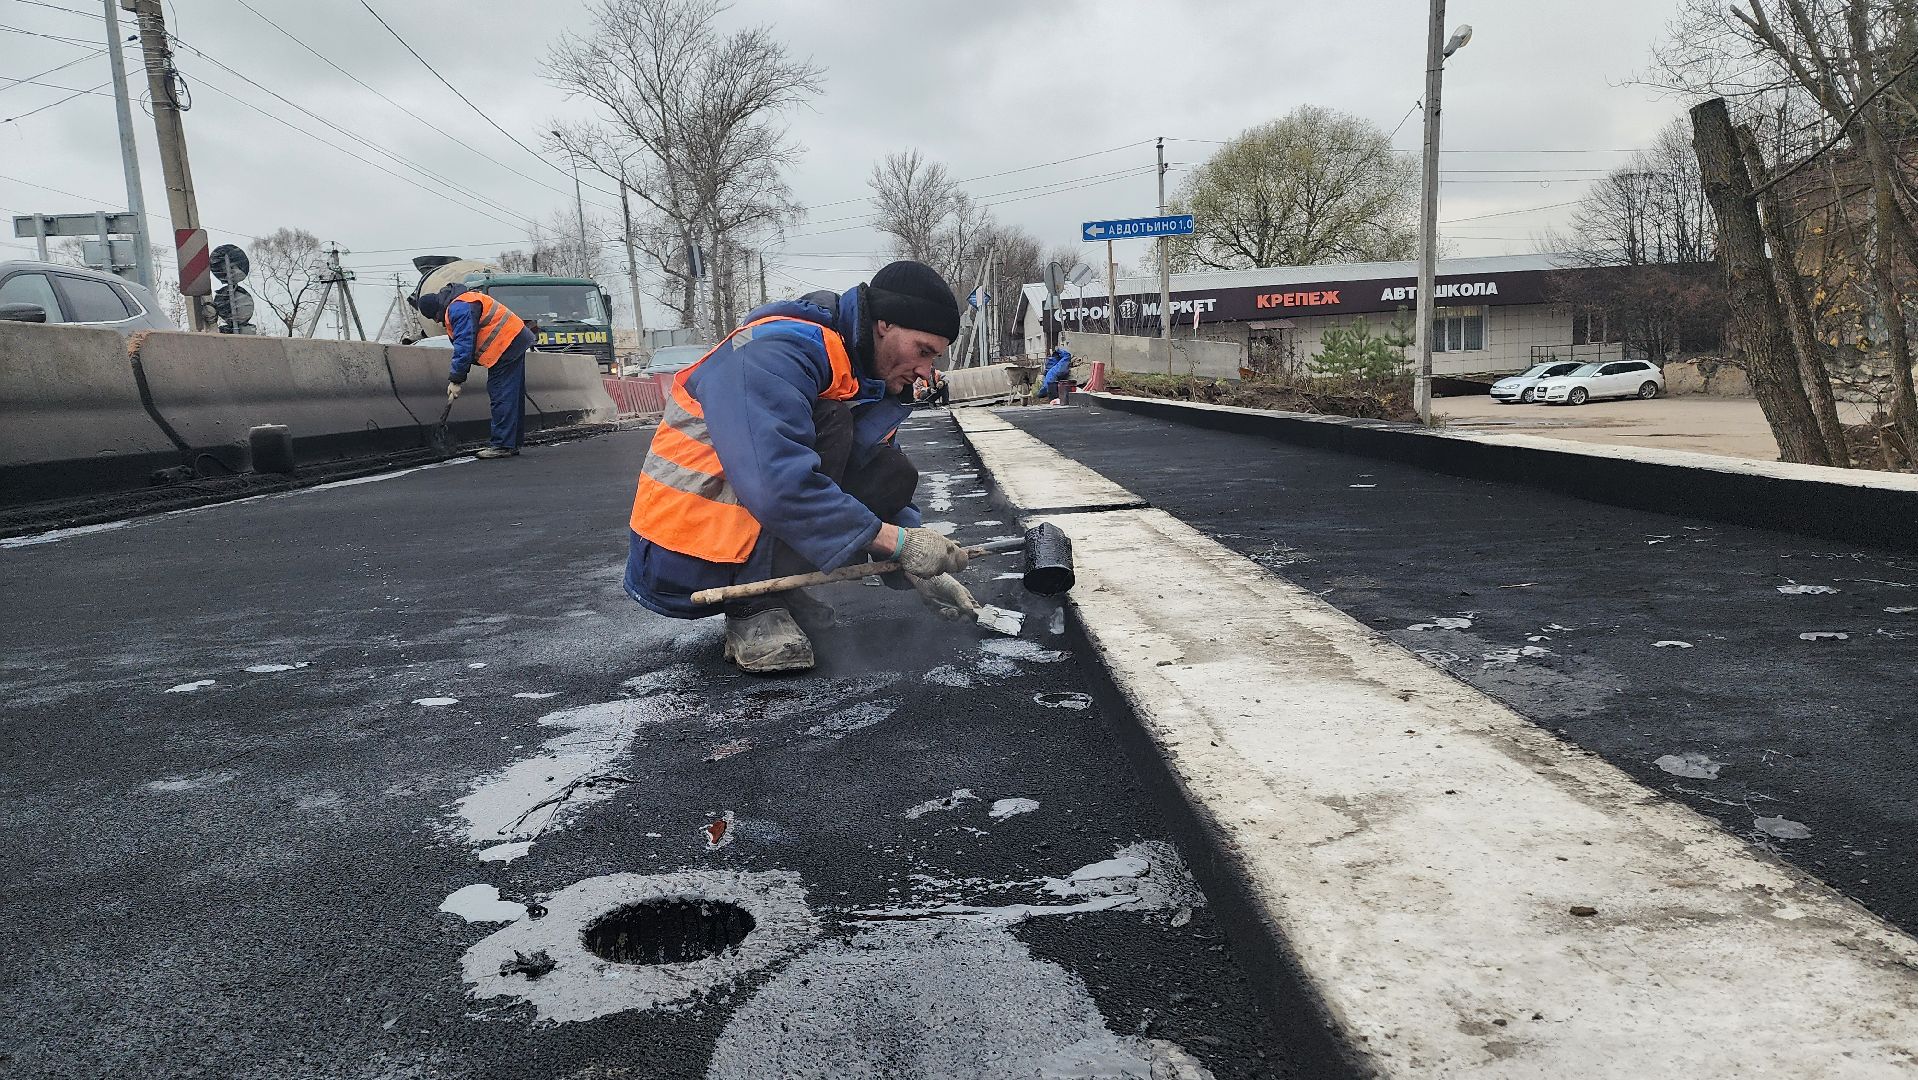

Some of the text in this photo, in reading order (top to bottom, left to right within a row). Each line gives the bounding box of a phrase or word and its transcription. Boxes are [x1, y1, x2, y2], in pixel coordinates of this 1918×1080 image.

[1108, 219, 1193, 235] АВДОТЬИНО 1,0
[1257, 290, 1341, 309] КРЕПЕЖ
[1380, 281, 1499, 301] АВТШКОЛА
